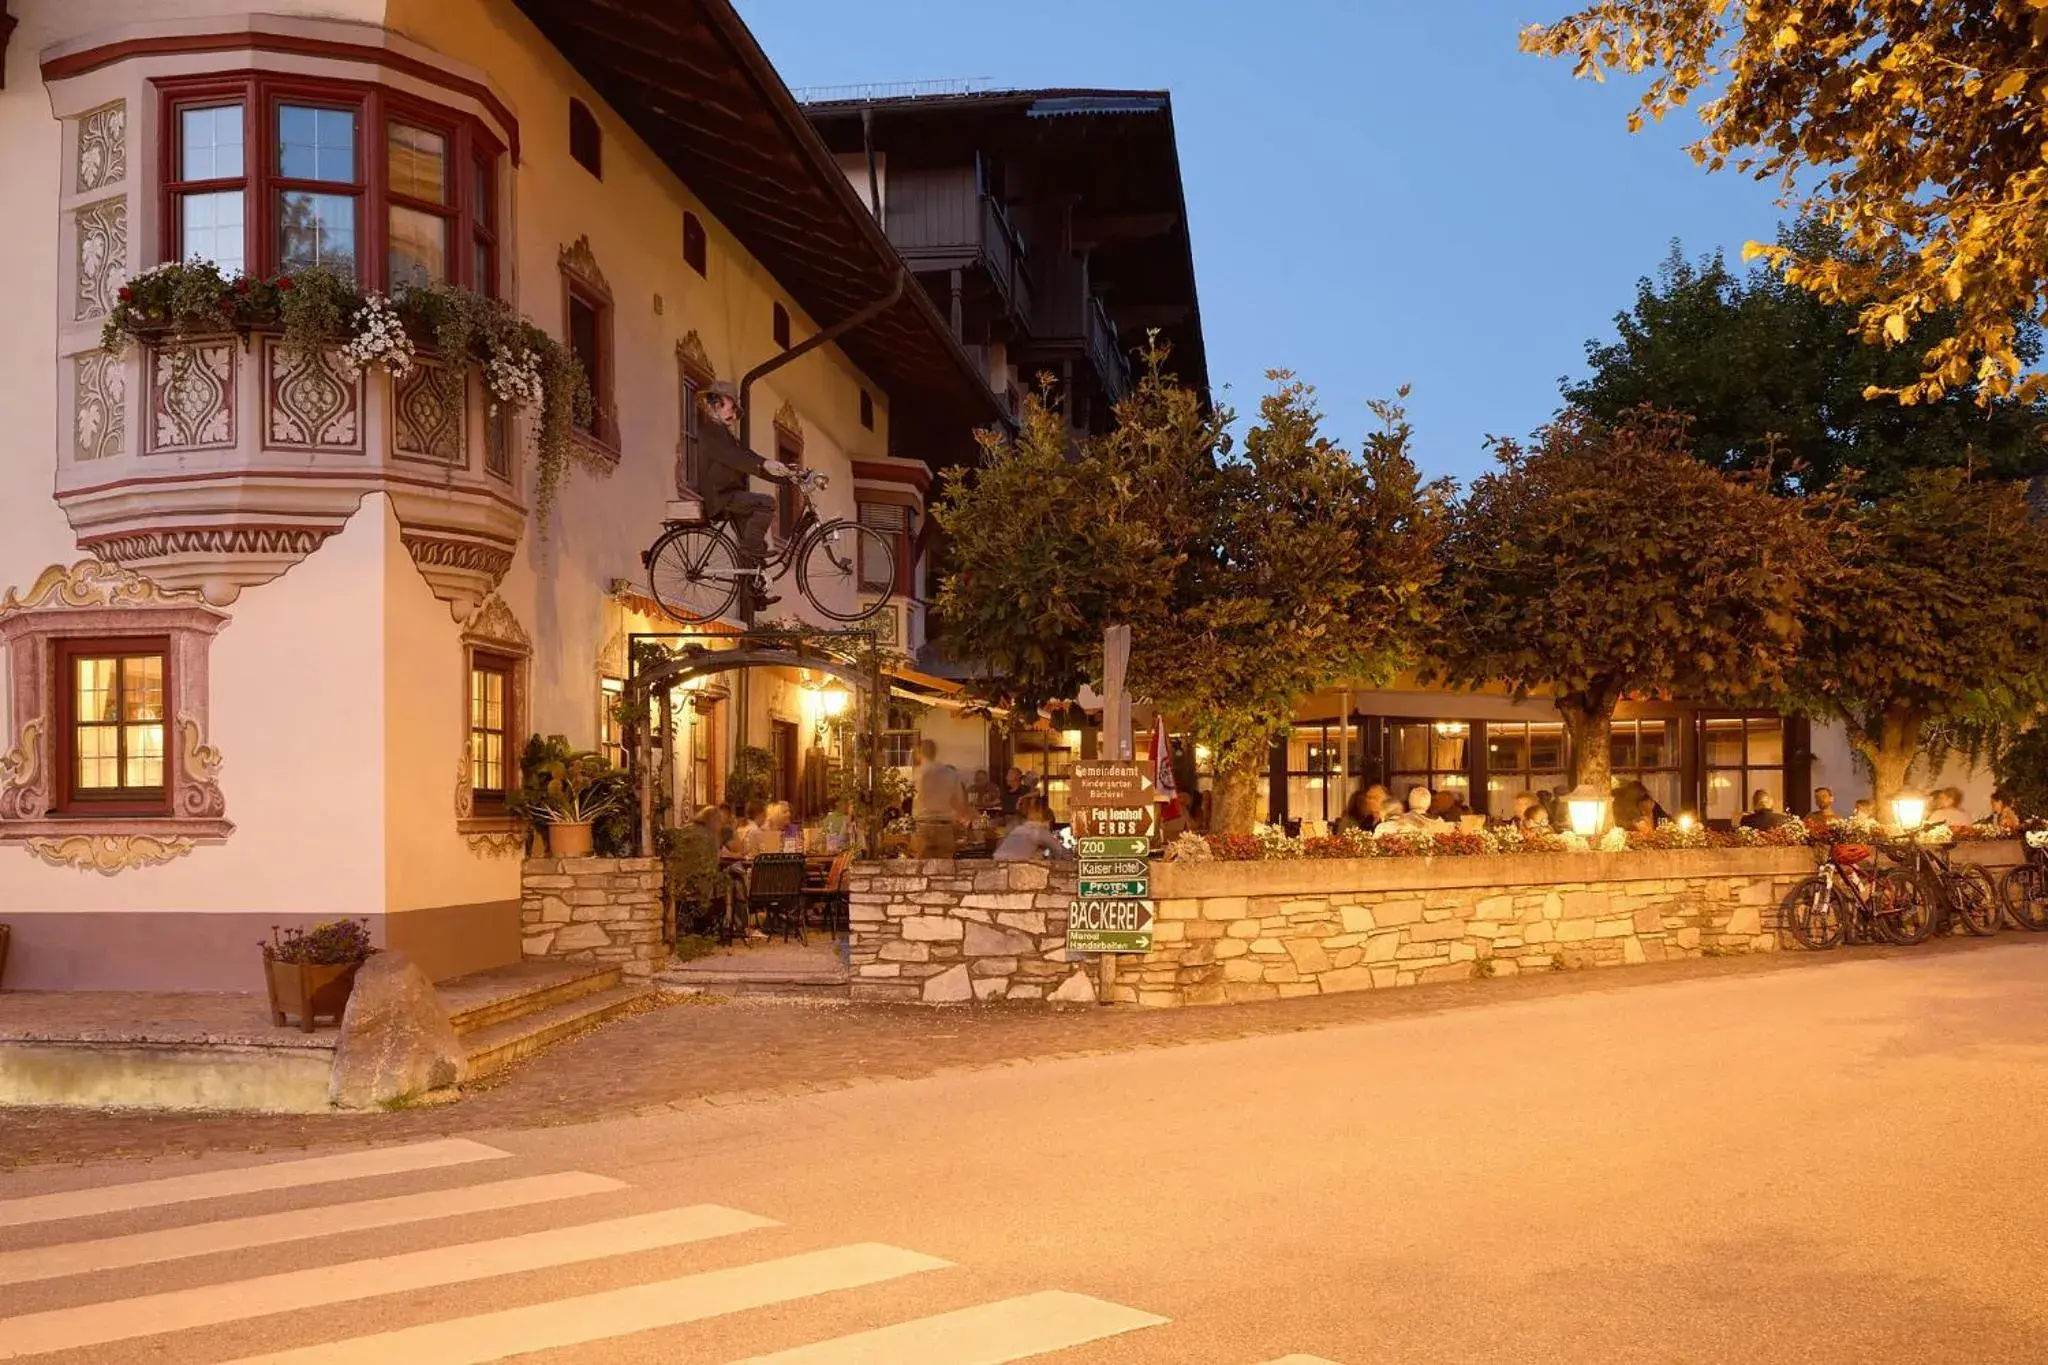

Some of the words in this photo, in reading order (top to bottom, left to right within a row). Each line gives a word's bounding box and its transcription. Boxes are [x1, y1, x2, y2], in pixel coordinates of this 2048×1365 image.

[1075, 765, 1138, 777] Gemeindeamt
[1082, 841, 1105, 853] ZOO
[1082, 862, 1112, 874] Kaiser
[1114, 861, 1140, 873] Hotel
[1070, 901, 1138, 930] BÄCKEREI
